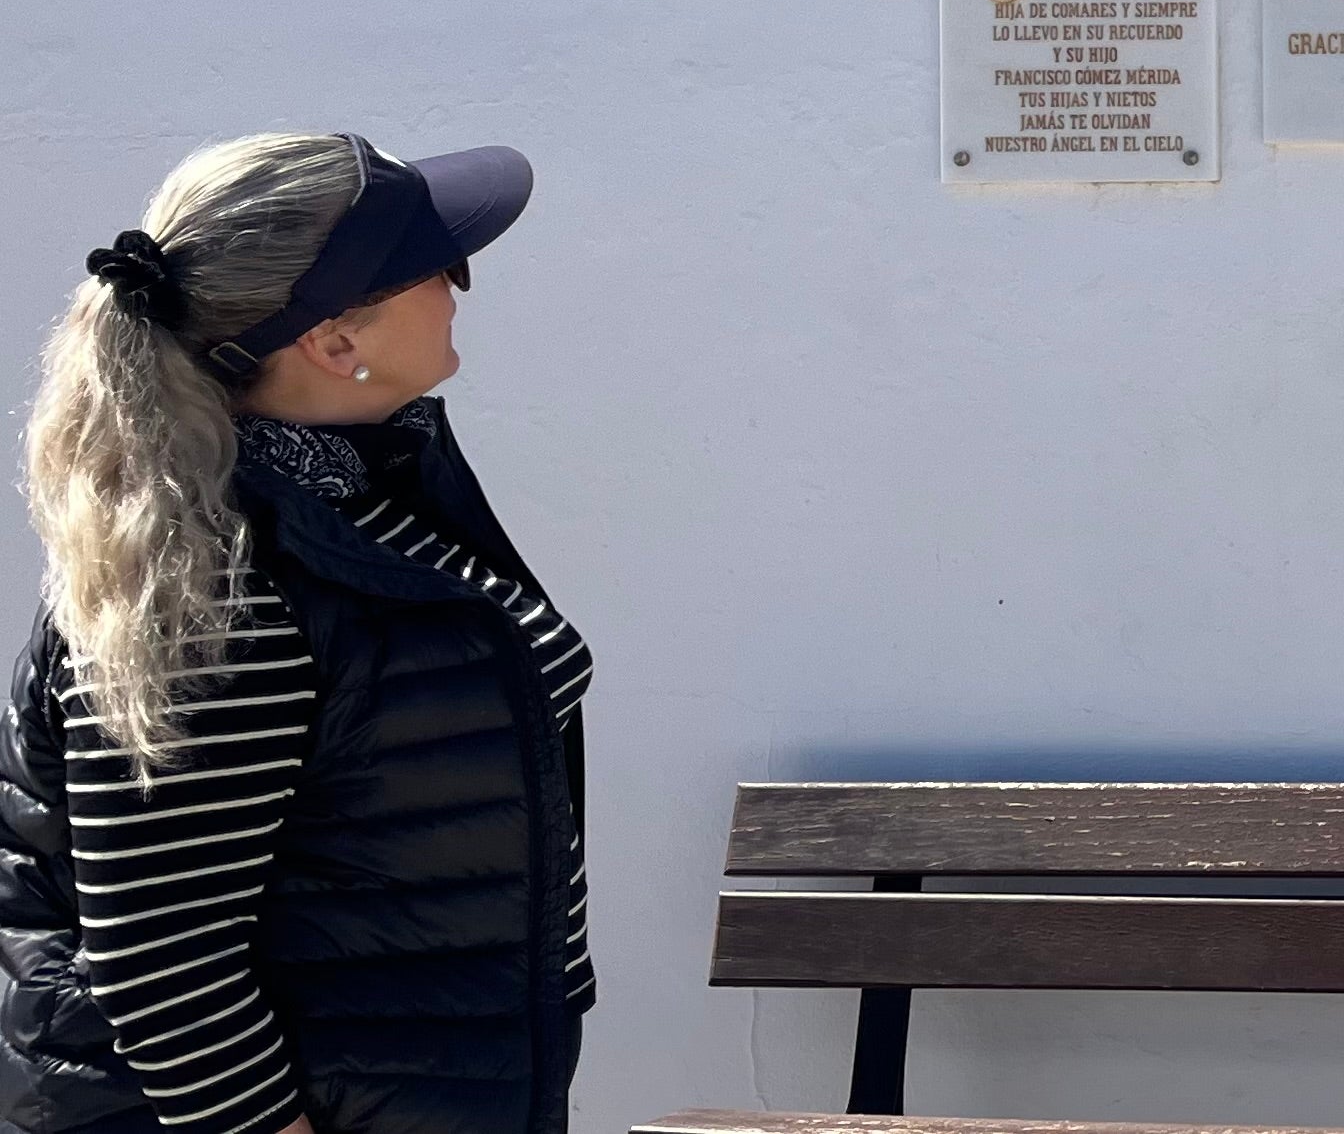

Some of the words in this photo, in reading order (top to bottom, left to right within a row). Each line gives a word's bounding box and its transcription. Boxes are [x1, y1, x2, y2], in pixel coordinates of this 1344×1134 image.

[995, 2, 1024, 20] HIJA
[1030, 3, 1047, 18] DE
[1052, 2, 1117, 18] COMARES
[1122, 3, 1130, 18] Y
[1135, 2, 1197, 17] SIEMPRE
[993, 26, 1009, 41] LO
[1014, 26, 1058, 41] LLEVO
[1063, 25, 1081, 40] EN
[1087, 25, 1104, 40] SU
[1109, 24, 1182, 40] RECUERDO
[1053, 47, 1061, 63] Y
[1066, 47, 1084, 62] SU
[1089, 47, 1117, 64] HIJO
[995, 70, 1071, 85] FRANCISCO
[1075, 66, 1121, 85] GÓMEZ
[1126, 66, 1181, 85] MÉRIDA
[1019, 92, 1046, 107] TUS
[1050, 92, 1088, 109] HIJAS
[1093, 92, 1101, 107] Y
[1106, 91, 1156, 107] NIETOS
[1020, 111, 1064, 131] JAMÁS
[1069, 114, 1087, 129] TE
[1092, 114, 1150, 129] OLVIDAN
[985, 136, 1047, 152] NUESTRO
[1051, 134, 1095, 152] ÁNGEL
[1100, 136, 1118, 151] EN
[1123, 136, 1140, 152] EL
[1144, 136, 1183, 151] CIELO
